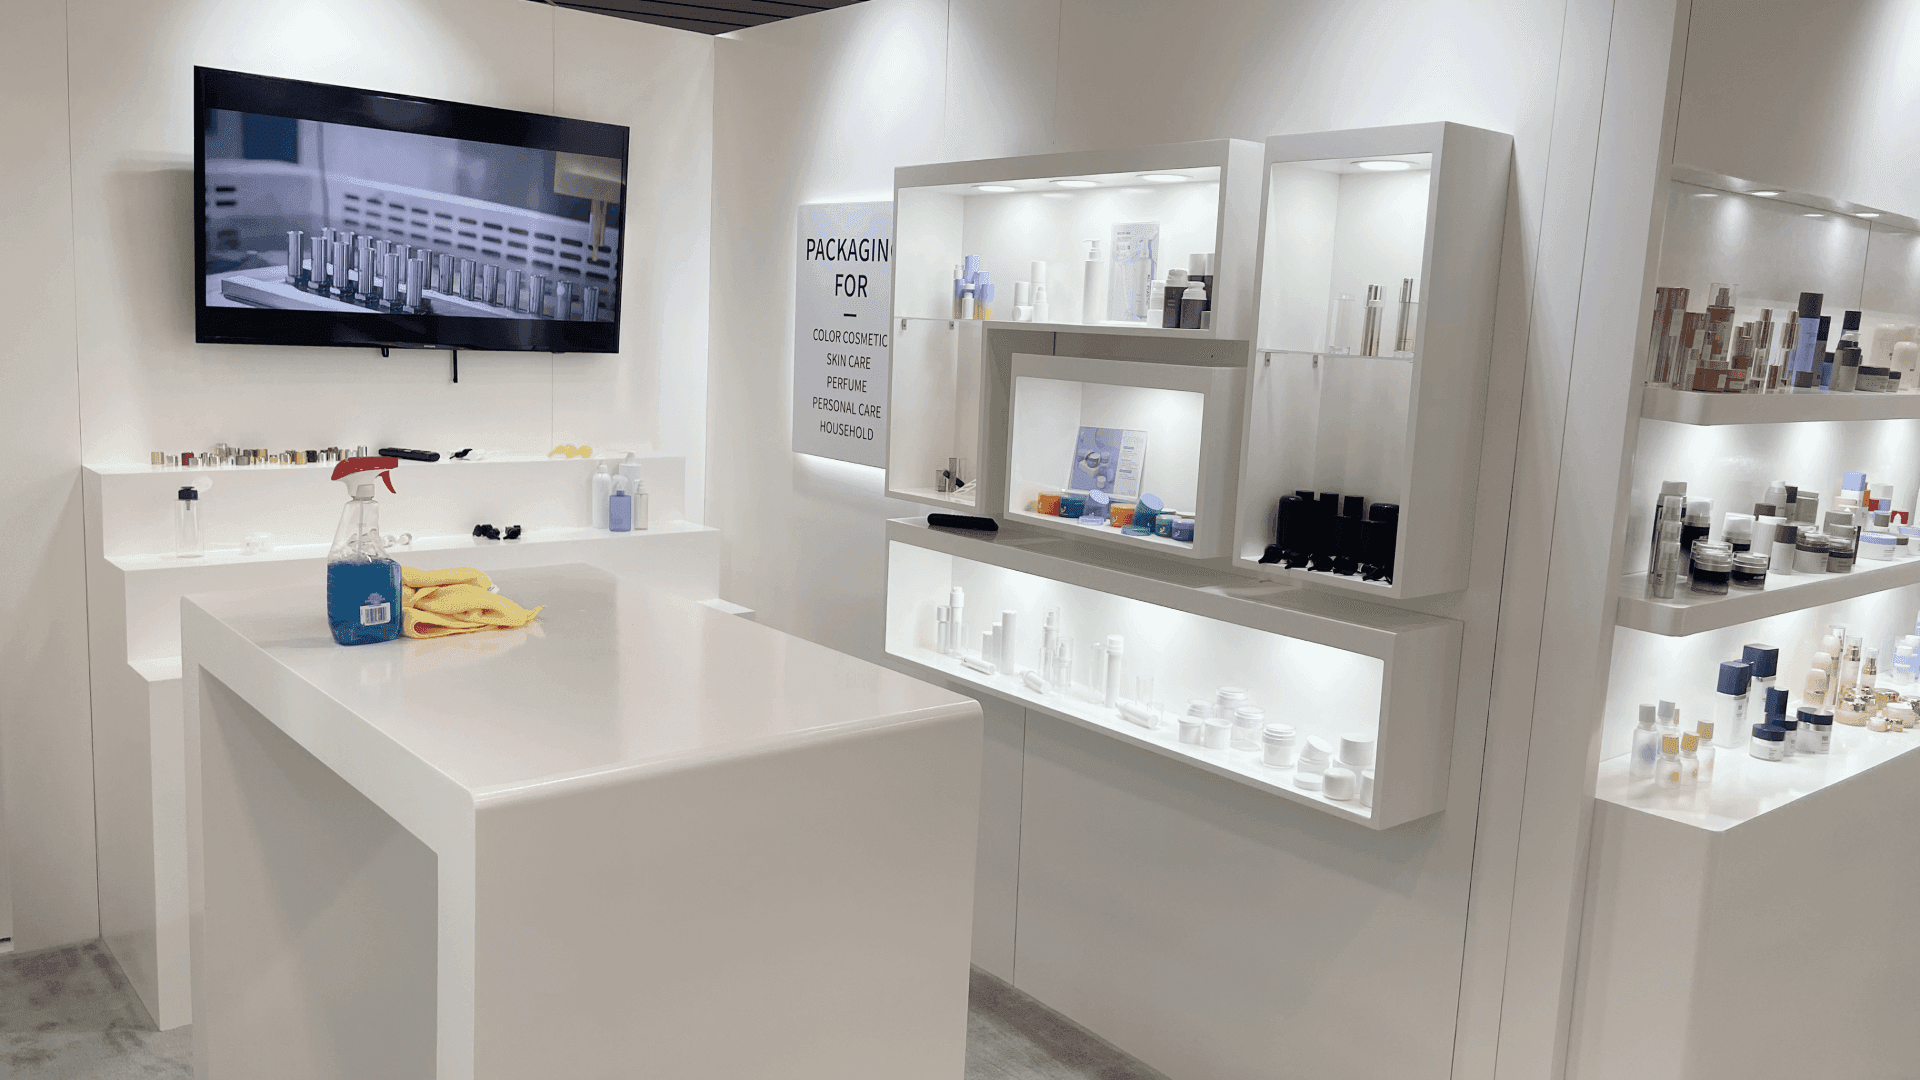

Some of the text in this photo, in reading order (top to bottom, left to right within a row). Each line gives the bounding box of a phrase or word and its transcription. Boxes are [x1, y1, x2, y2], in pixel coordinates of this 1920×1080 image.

[806, 238, 893, 262] PACKAGIN
[835, 273, 868, 298] FOR
[812, 328, 888, 347] COLOR COSMETIC
[826, 352, 871, 370] SKIN CARE
[826, 375, 867, 393] PERFUME
[812, 396, 882, 419] PERSONAL CARE
[819, 420, 874, 441] HOUSEHOLD
